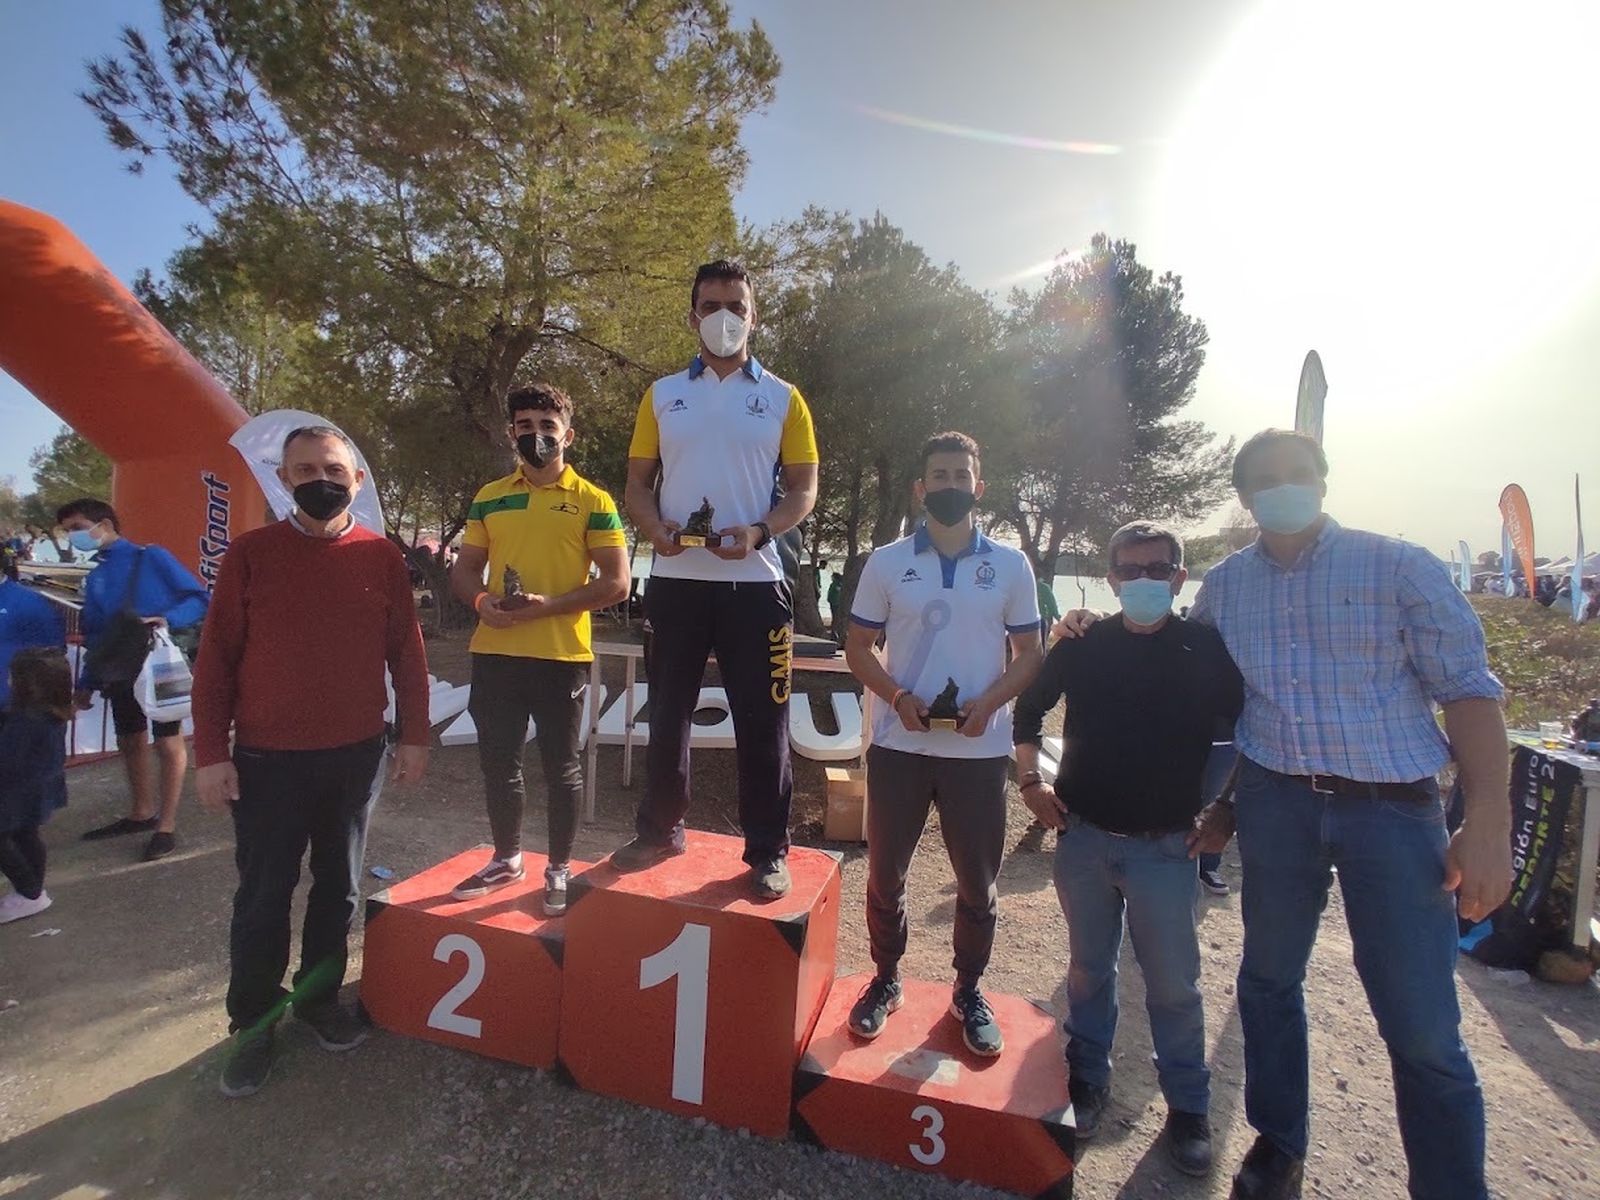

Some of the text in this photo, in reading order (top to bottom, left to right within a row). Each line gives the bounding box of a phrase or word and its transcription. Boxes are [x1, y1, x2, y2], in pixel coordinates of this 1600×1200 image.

[200, 471, 231, 594] fiSport
[1512, 820, 1534, 878] gión
[426, 934, 485, 1038] 2
[639, 922, 711, 1105] 1
[909, 1105, 945, 1165] 3
